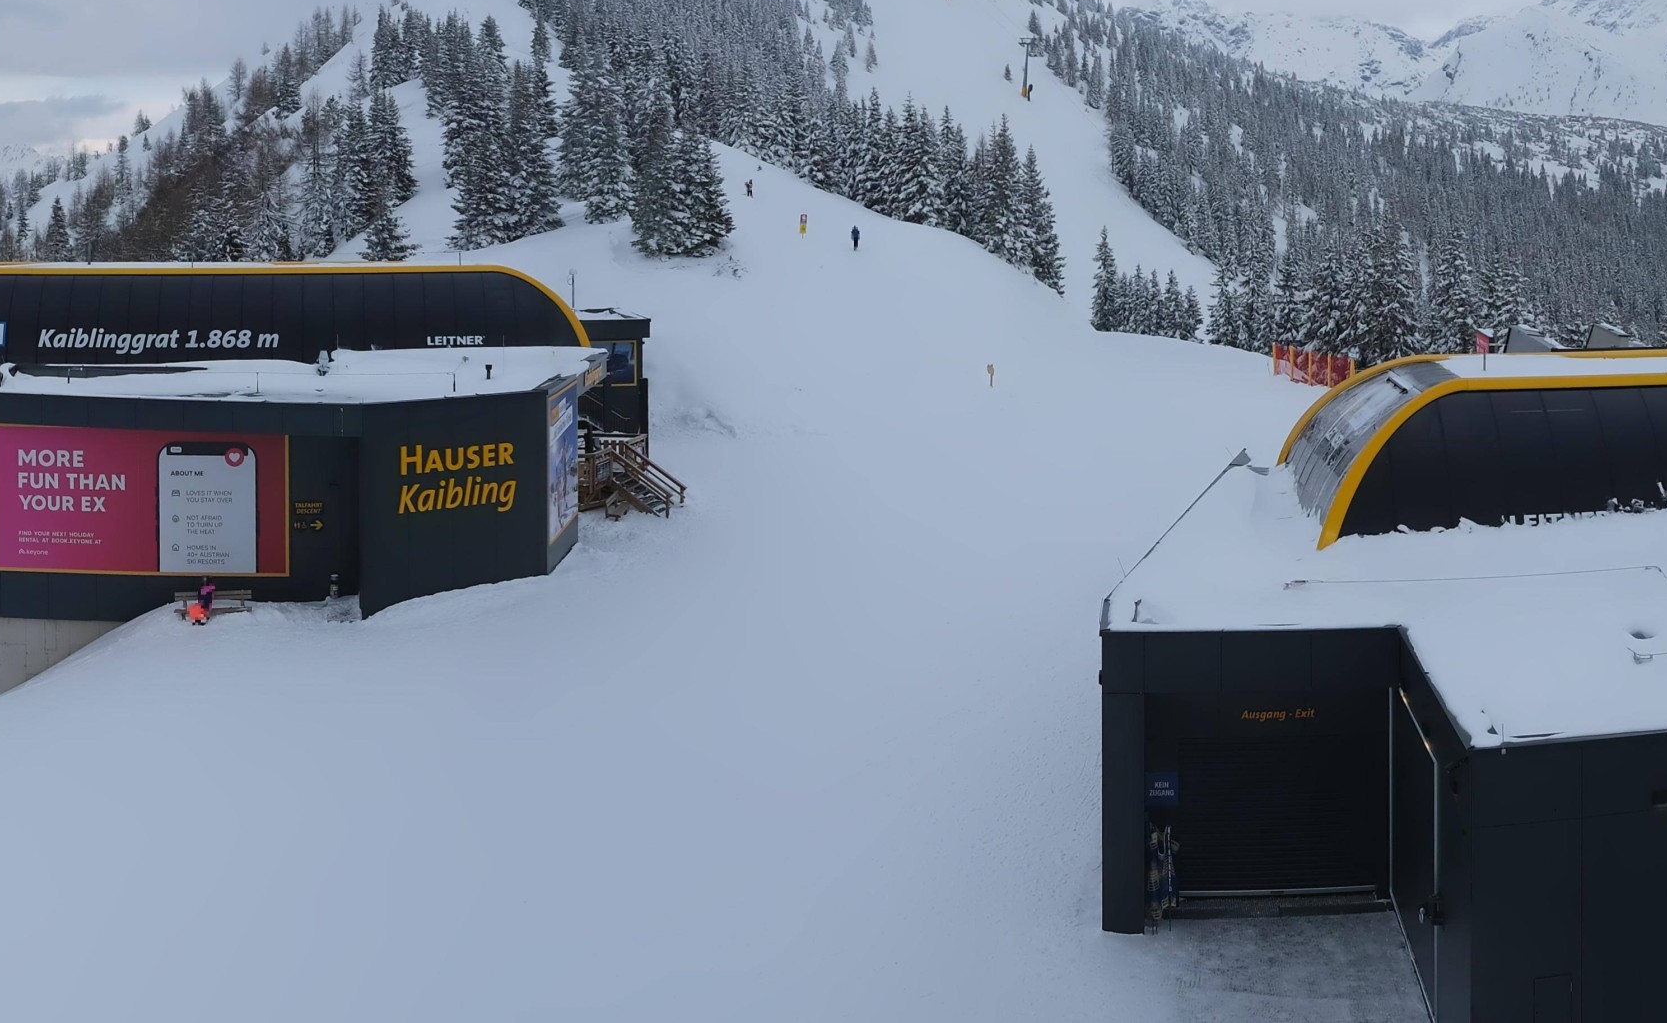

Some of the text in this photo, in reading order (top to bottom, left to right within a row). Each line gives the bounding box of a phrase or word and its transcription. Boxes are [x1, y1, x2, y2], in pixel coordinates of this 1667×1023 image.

[37, 327, 280, 355] Kaiblinggrat 1.868 m
[426, 335, 484, 346] LEITNER
[17, 449, 84, 468] MORE
[400, 442, 515, 476] HAUSER
[17, 472, 126, 491] FUN THAN
[18, 494, 107, 513] YOUR EX
[398, 476, 517, 514] Kaibling
[26, 548, 49, 556] keyone
[1241, 709, 1287, 722] Ausgang
[1295, 708, 1315, 719] Exit
[1154, 781, 1169, 789] KEIN
